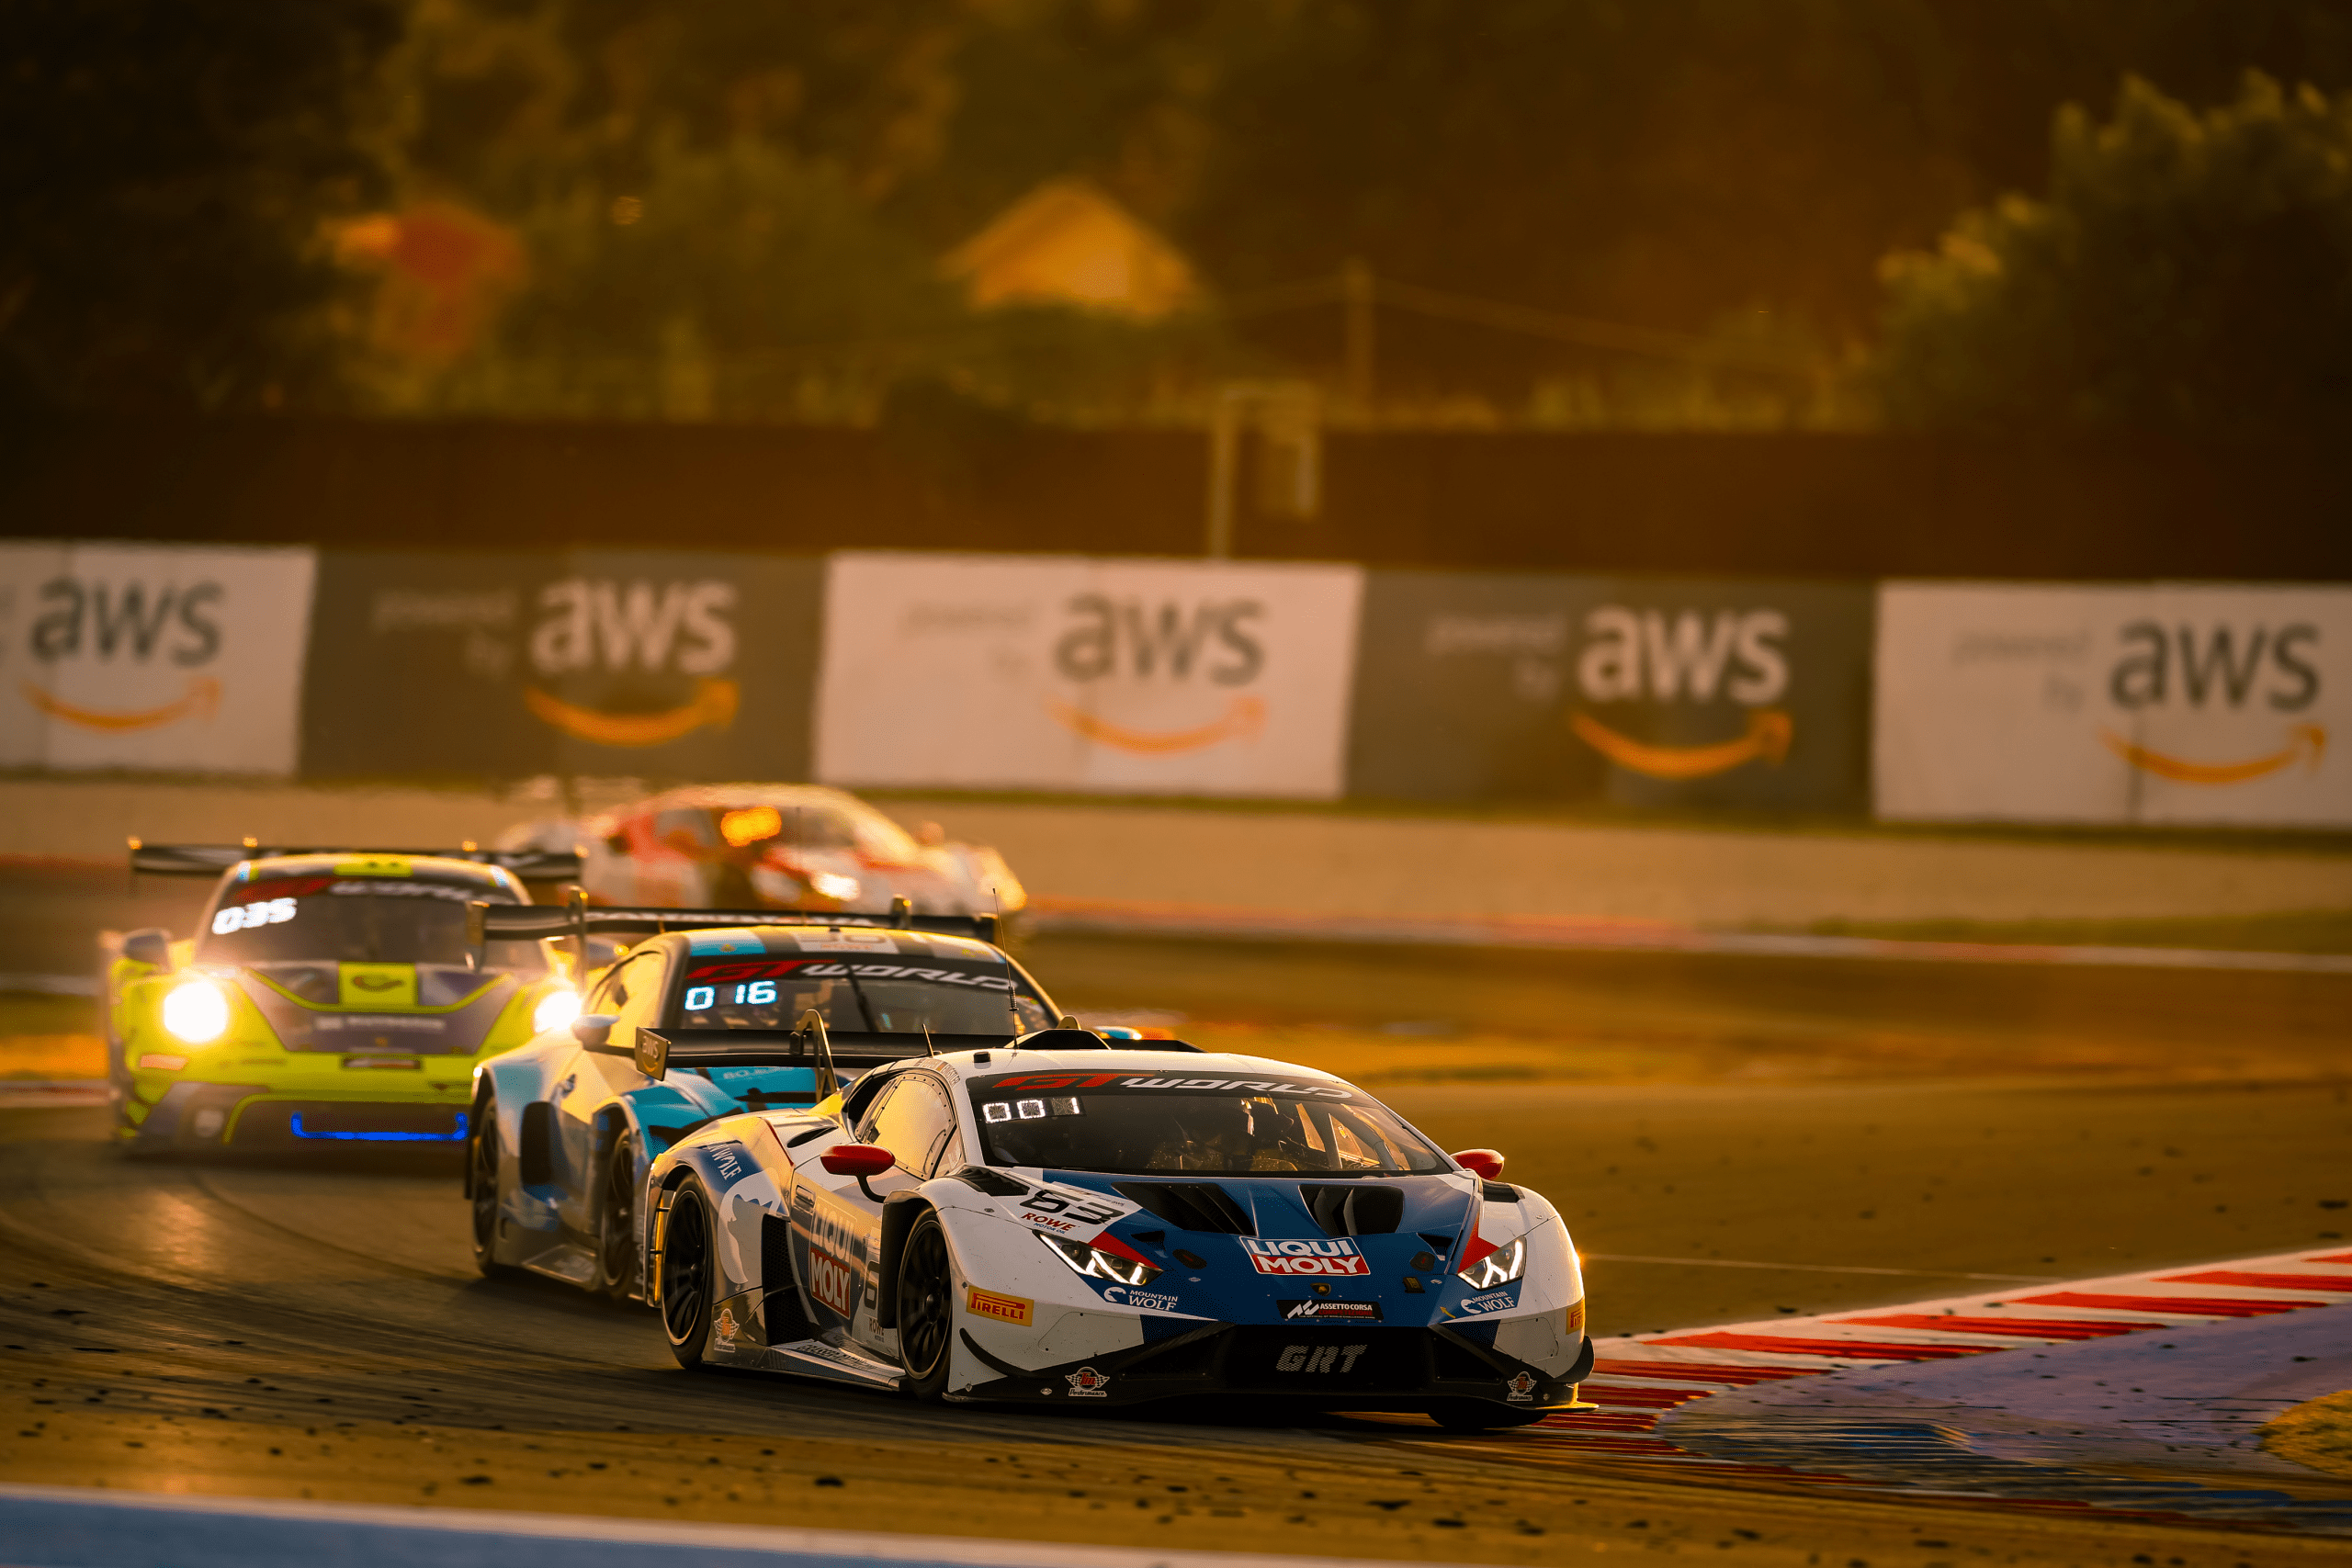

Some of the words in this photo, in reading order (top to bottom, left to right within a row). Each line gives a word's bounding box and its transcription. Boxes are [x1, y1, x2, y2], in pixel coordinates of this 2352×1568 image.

[30, 575, 222, 667] aws
[531, 578, 736, 673] aws
[1053, 592, 1265, 687] aws
[1577, 604, 1790, 704] aws
[2109, 617, 2320, 712] aws
[800, 964, 1018, 990] WORLD
[1120, 1077, 1352, 1099] WORLD
[1020, 1189, 1125, 1225] 63
[1021, 1213, 1076, 1232] ROWE
[1247, 1239, 1354, 1257] LIQUI
[1256, 1256, 1361, 1274] MOLY
[810, 1251, 850, 1312] MOLY
[971, 1292, 1026, 1320] PIRELLI
[1128, 1295, 1177, 1311] WOLF
[1129, 1290, 1179, 1303] MOUNTAIN
[1472, 1291, 1509, 1303] MOUNTAIN
[1477, 1296, 1516, 1312] WOLF
[1275, 1344, 1368, 1373] GRT
